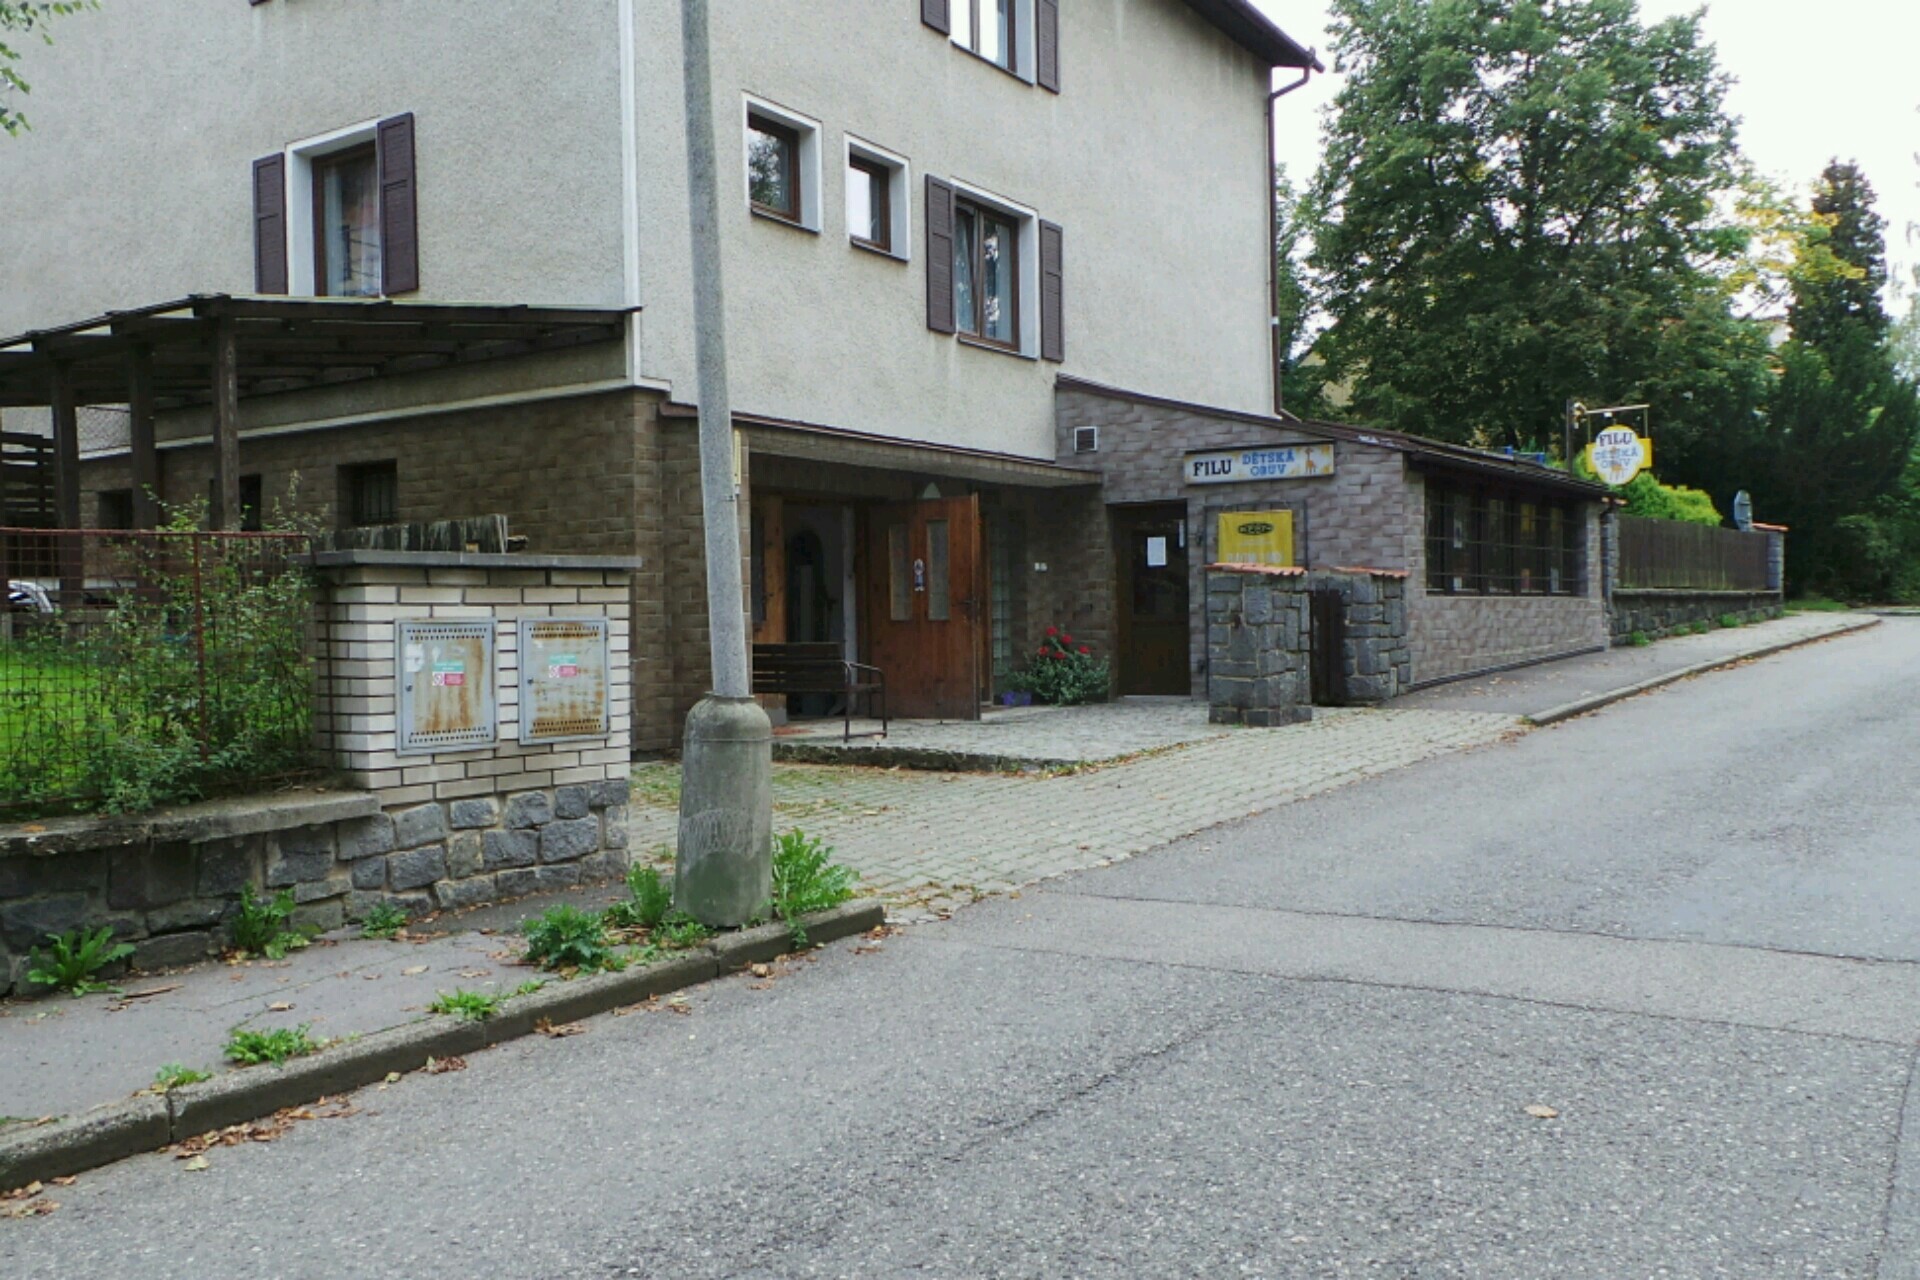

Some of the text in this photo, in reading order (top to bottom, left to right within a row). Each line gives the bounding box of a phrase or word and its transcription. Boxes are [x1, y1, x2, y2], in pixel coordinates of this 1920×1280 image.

[1600, 433, 1632, 447] FILU
[1193, 459, 1232, 476] FILU
[1250, 464, 1286, 476] OBUV
